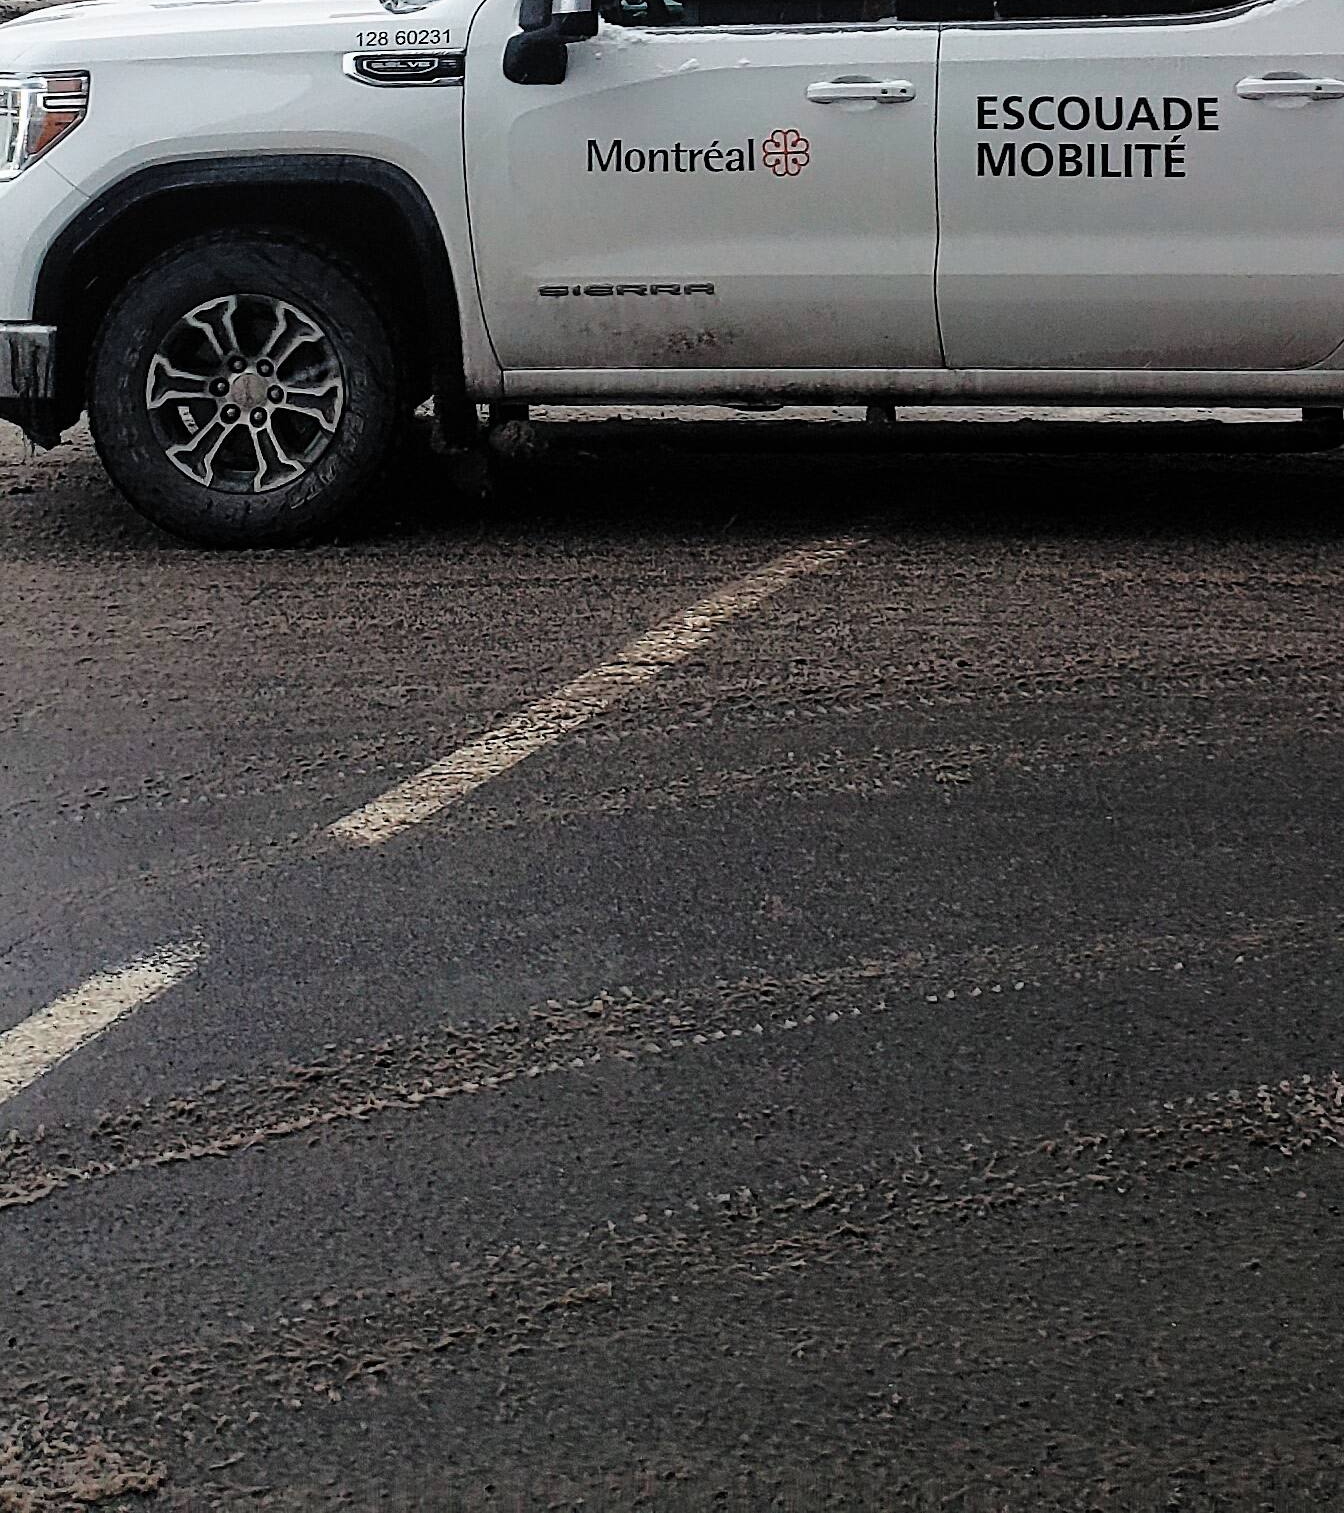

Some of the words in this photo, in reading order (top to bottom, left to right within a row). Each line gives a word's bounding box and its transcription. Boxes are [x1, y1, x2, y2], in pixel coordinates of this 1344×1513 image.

[356, 31, 388, 46] 128
[395, 29, 451, 46] 60231
[976, 95, 1219, 131] ESCOUADE
[587, 138, 755, 172] Montréal
[976, 134, 1187, 178] MOBILITÉ
[539, 283, 715, 297] SIERRA
